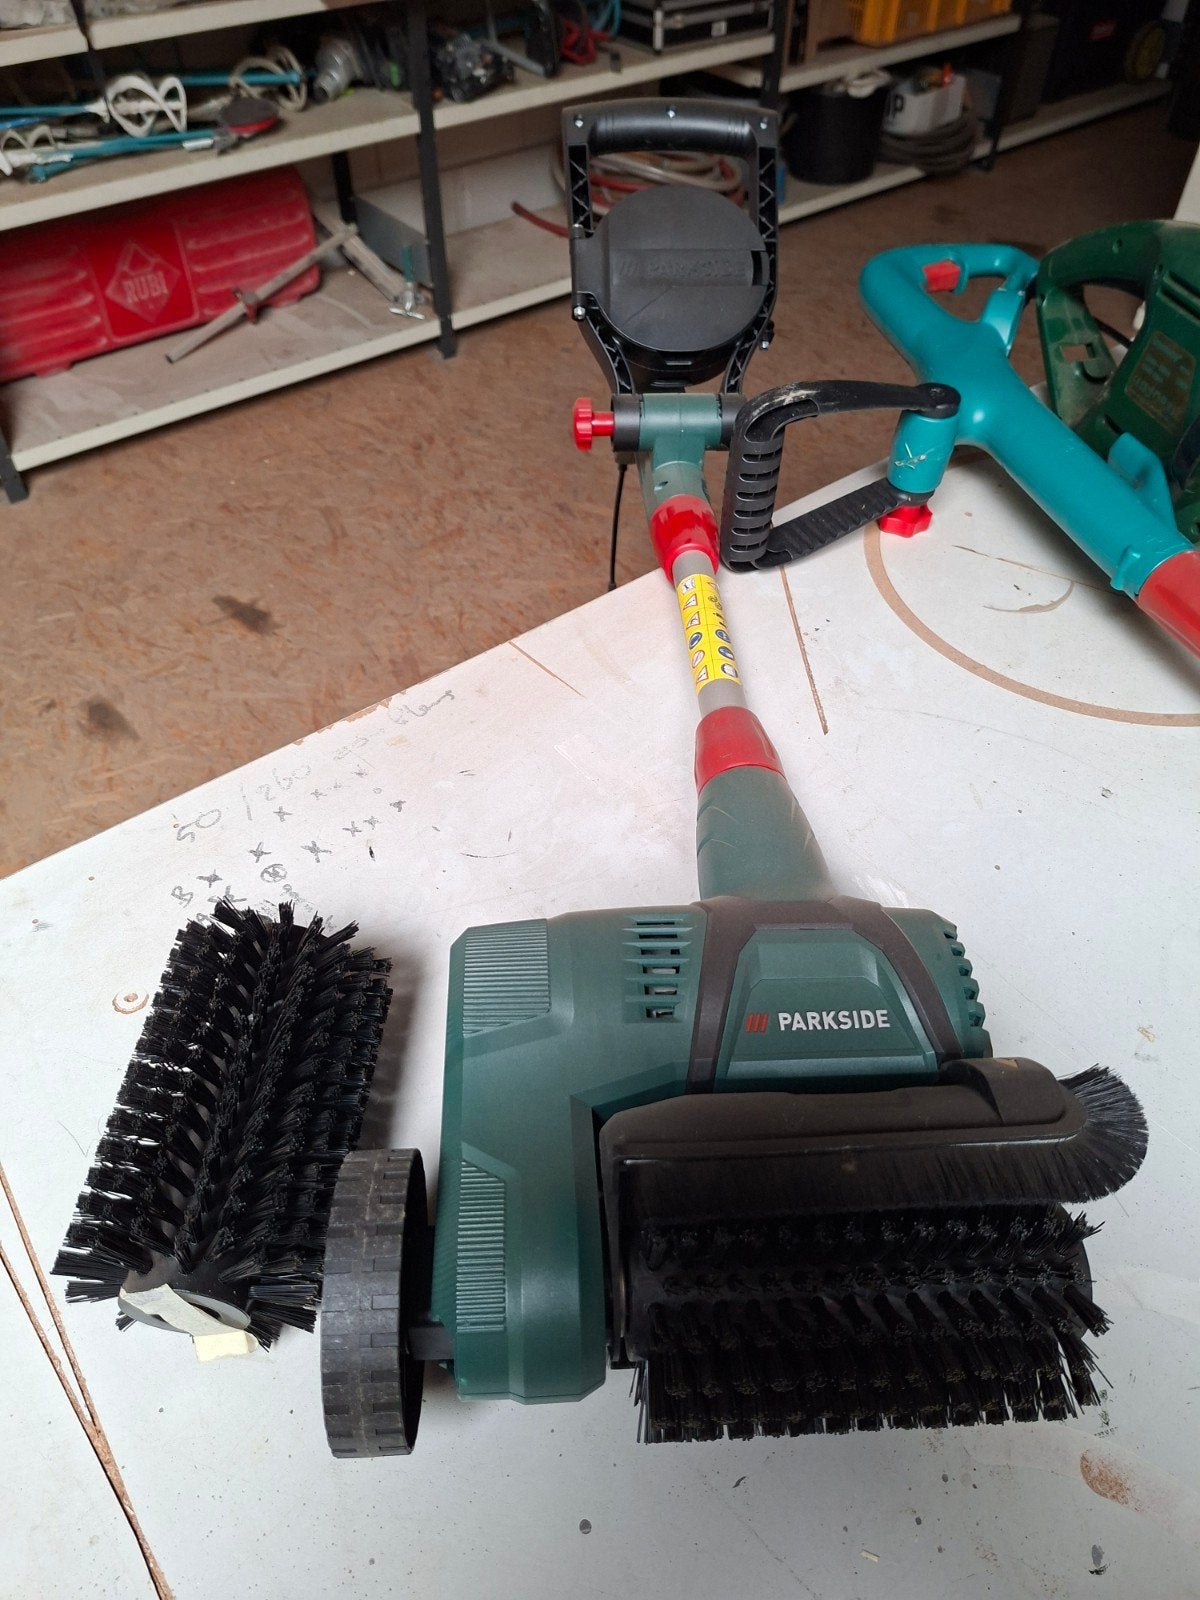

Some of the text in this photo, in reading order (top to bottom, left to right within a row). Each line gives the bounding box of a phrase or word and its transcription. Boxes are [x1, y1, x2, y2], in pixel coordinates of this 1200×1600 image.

[645, 257, 748, 279] PARKSIDE
[121, 270, 169, 304] RUBI
[778, 1009, 891, 1032] PARKSIDE
